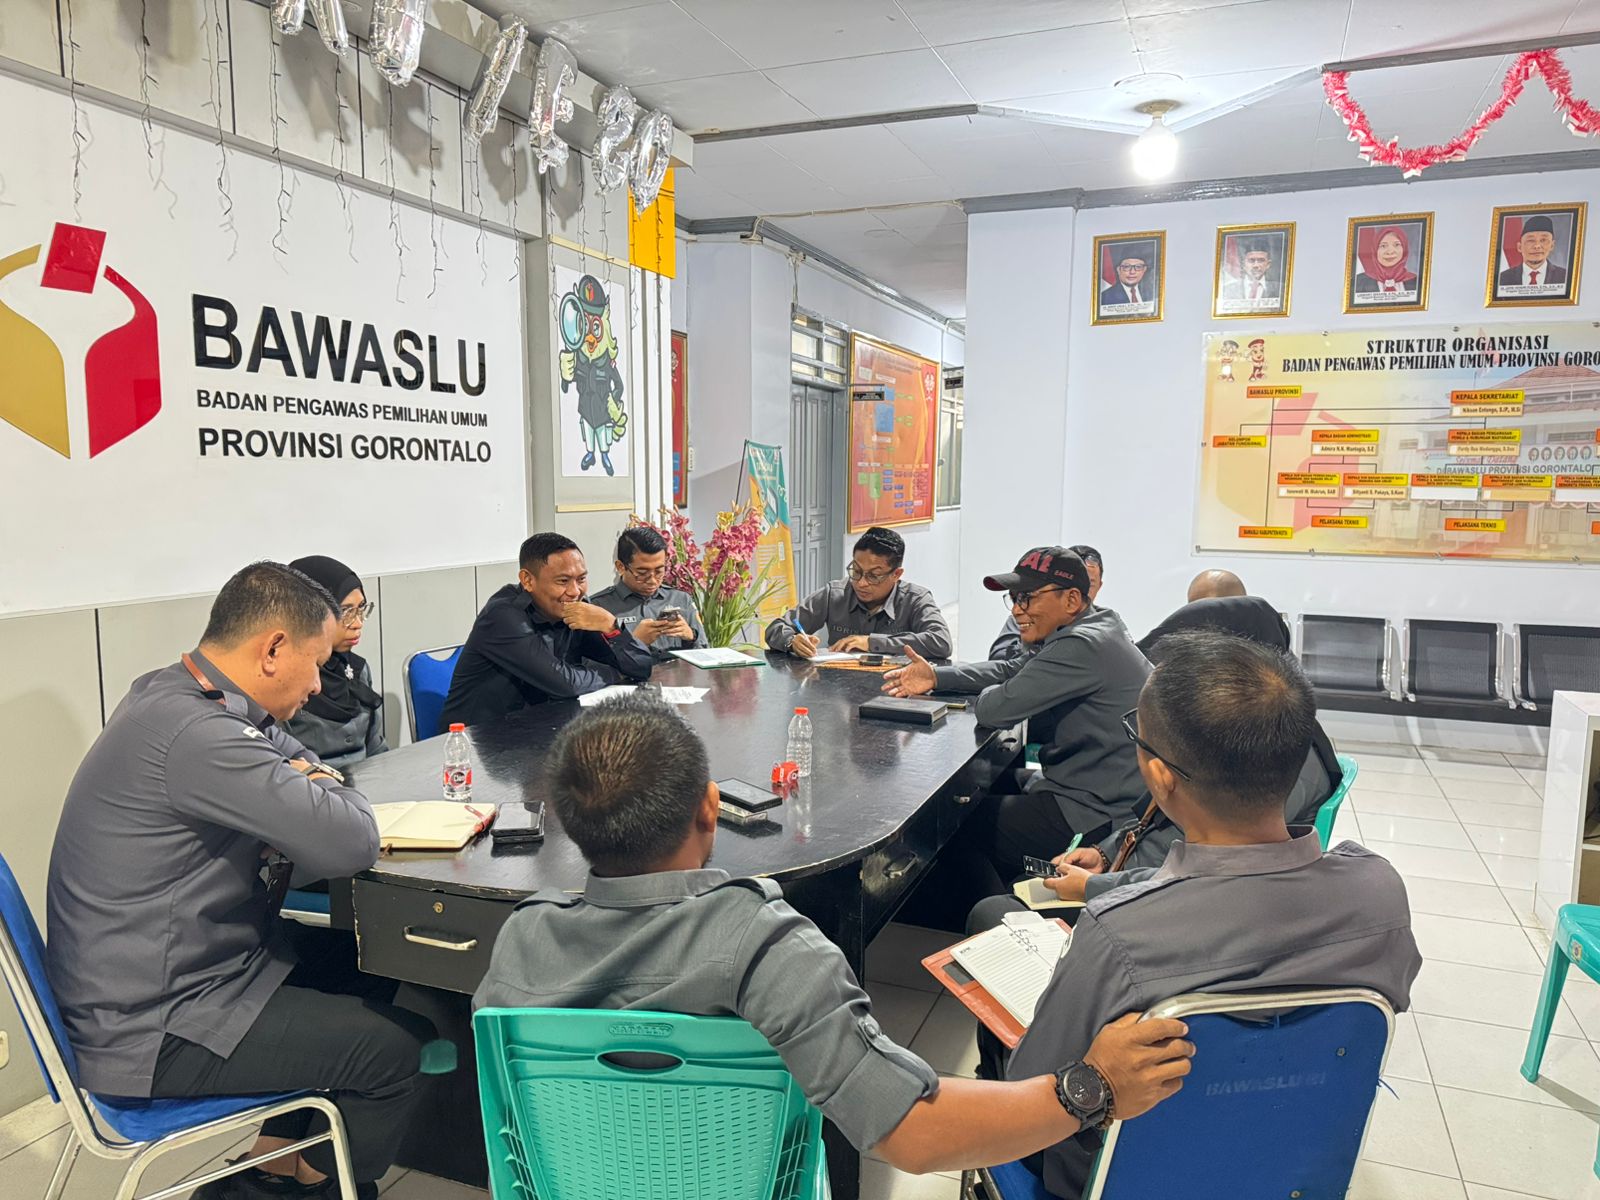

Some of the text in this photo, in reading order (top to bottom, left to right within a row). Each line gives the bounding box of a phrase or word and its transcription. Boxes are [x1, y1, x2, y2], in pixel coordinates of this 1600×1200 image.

[191, 293, 486, 397] BAWASLU
[1367, 335, 1550, 354] STRUKTUR ORGANISASI
[1282, 358, 1321, 372] BADAN
[1324, 356, 1386, 371] PENGAWAS
[1390, 354, 1456, 370] PEMILIHAN
[1460, 353, 1494, 369] UMUM
[1499, 352, 1560, 367] PROVINSI
[196, 389, 488, 427] BADAN PENGAWAS PEMILIHAN UMUM
[198, 427, 492, 463] PROVINSI GORONTALO
[1488, 464, 1531, 474] PROVINSI
[1533, 463, 1592, 473] GORONTALO
